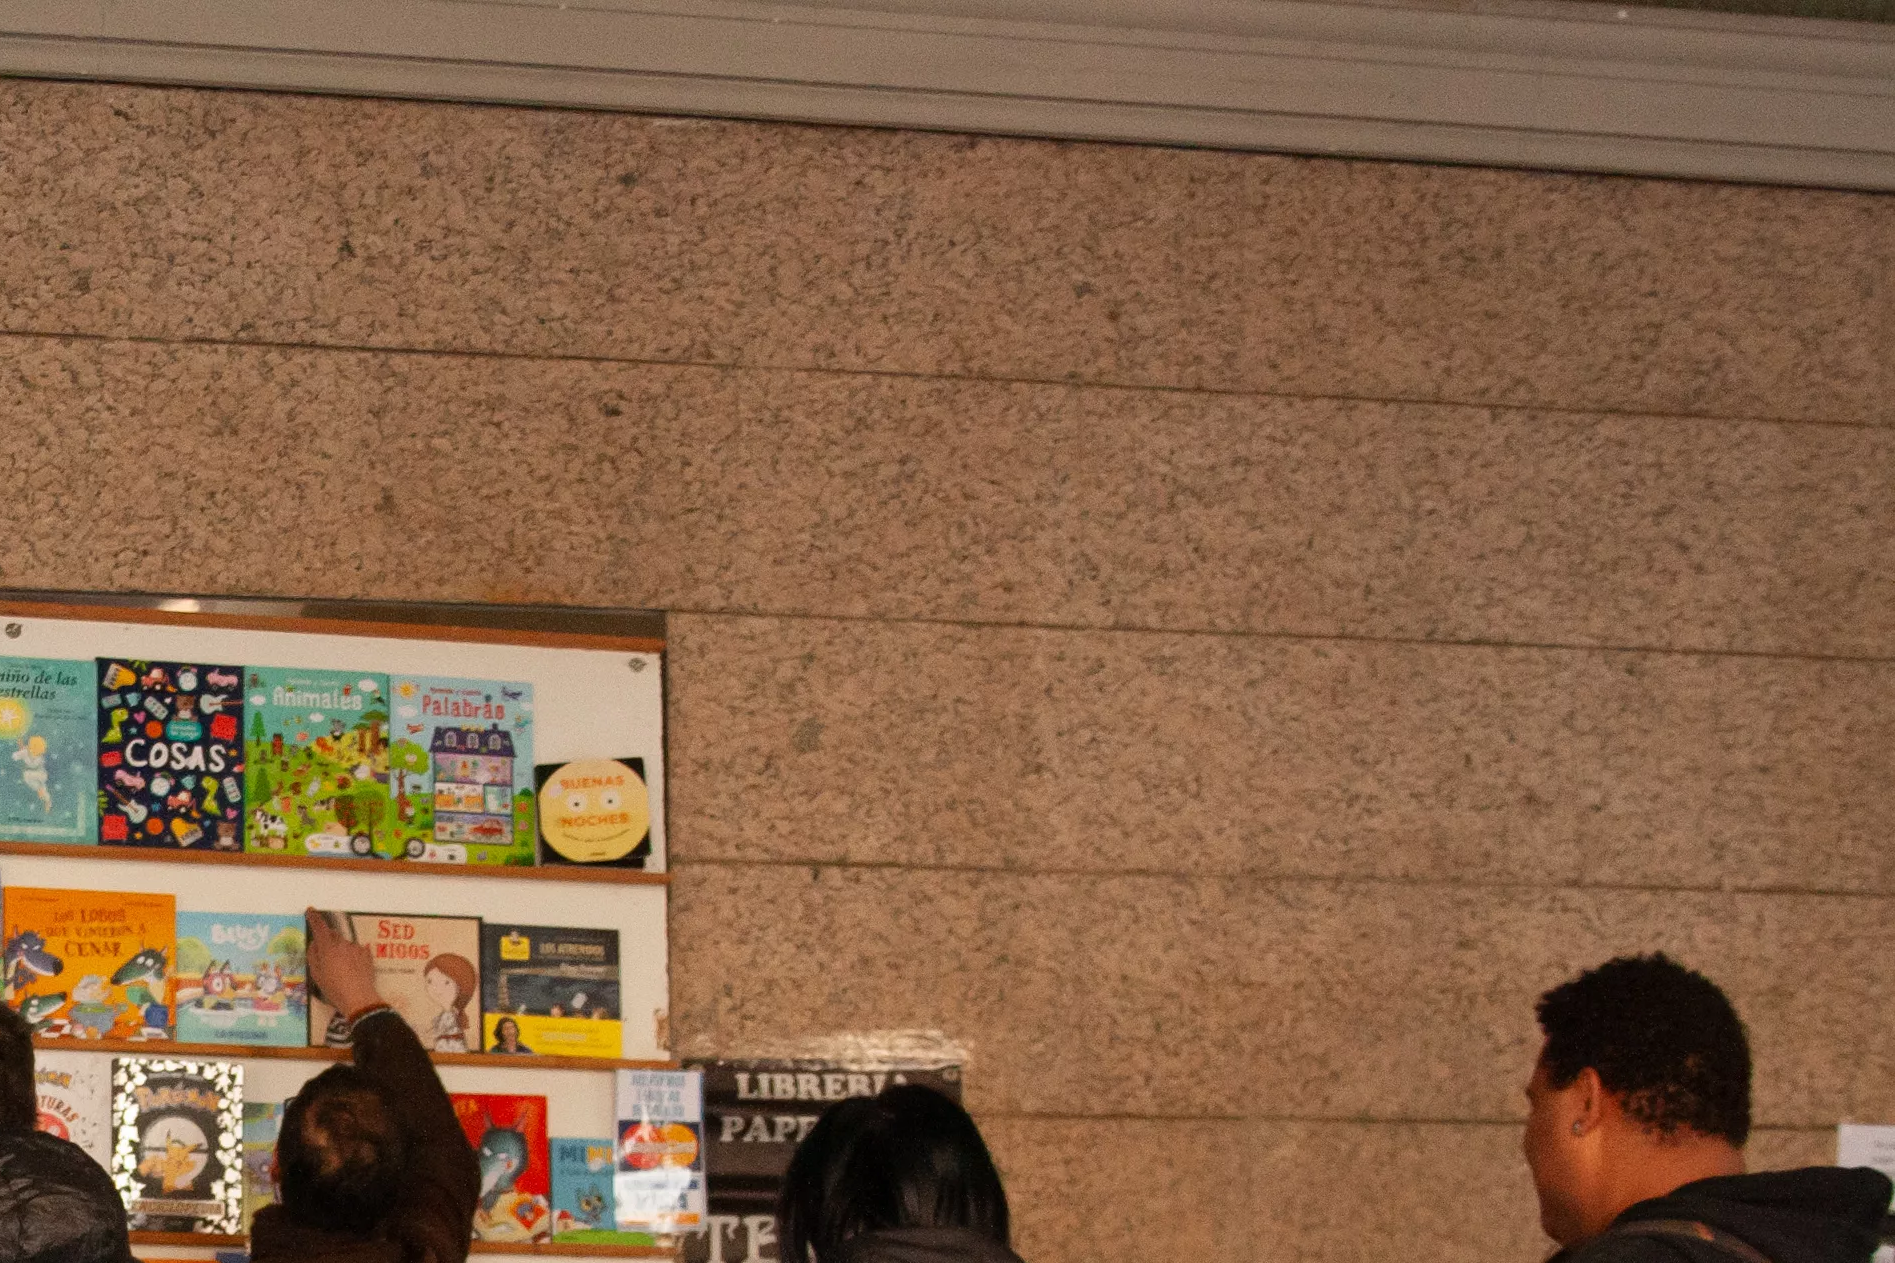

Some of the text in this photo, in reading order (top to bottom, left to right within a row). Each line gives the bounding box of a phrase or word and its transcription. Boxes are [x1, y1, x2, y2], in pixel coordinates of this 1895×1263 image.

[34, 670, 51, 685] de
[56, 672, 78, 687] las
[272, 687, 363, 710] Animales
[422, 694, 505, 720] Palabras
[125, 739, 227, 772] COSAS
[560, 775, 625, 790] BUENAS
[559, 813, 630, 828] NOCHES
[377, 919, 415, 940] SED
[735, 1073, 906, 1101] LIBRERI
